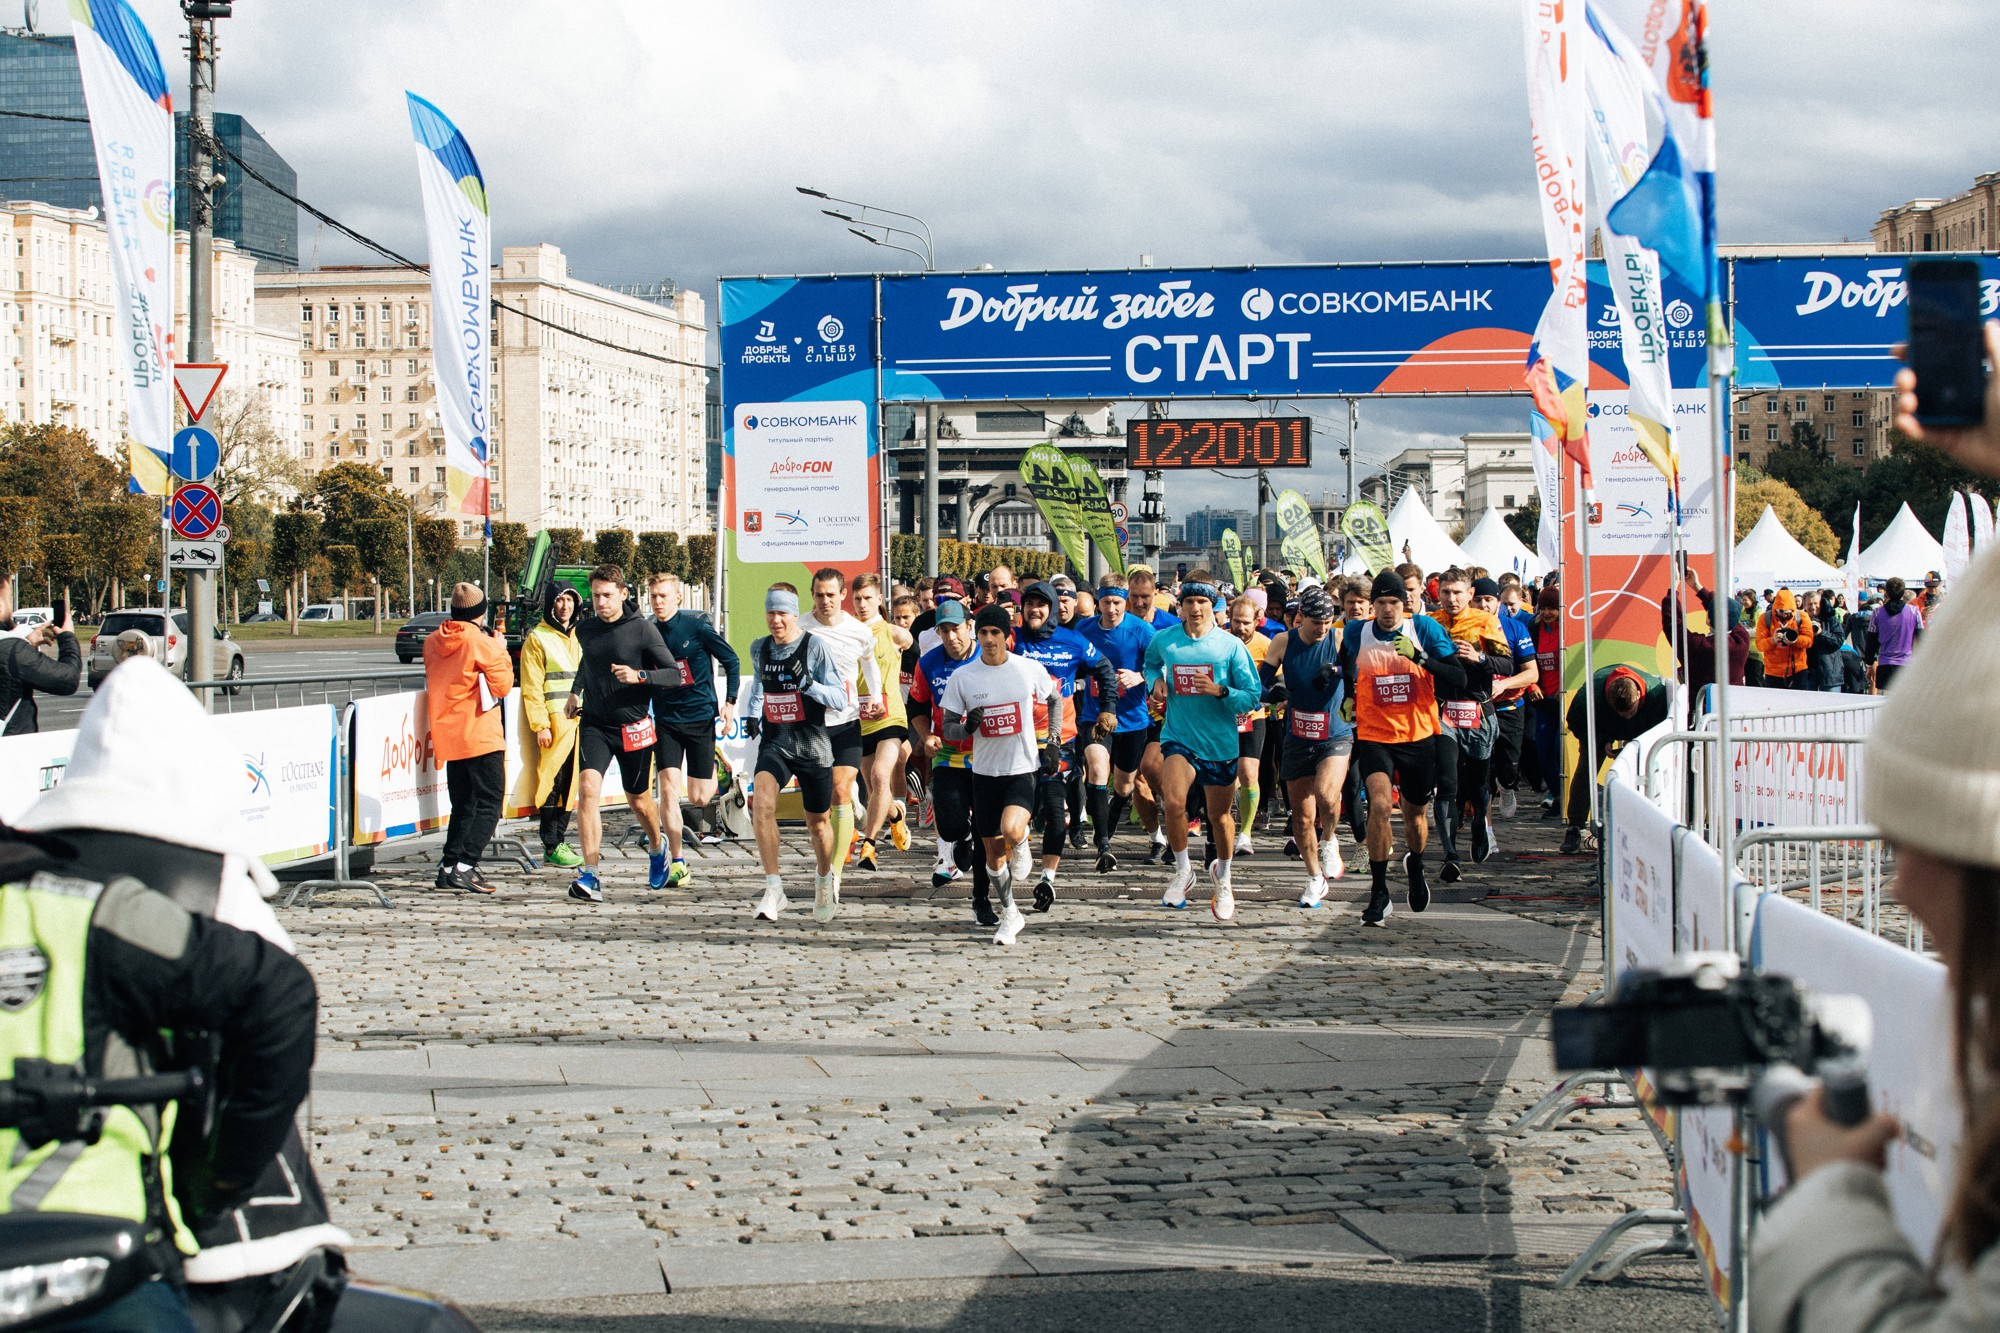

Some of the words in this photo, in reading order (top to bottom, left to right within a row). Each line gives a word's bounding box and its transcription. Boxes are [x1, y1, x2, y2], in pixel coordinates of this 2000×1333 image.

[1795, 267, 1910, 318] Добр
[939, 283, 1099, 331] Добрый
[1102, 280, 1215, 330] забег
[1278, 289, 1494, 315] СОВКОМБАНК
[1587, 330, 1622, 340] ДОБР
[1669, 330, 1705, 339] ТЕБЯ
[744, 345, 788, 355] ДОБРЫЕ
[822, 344, 855, 353] ТЕБЯ
[741, 354, 790, 364] ПРОЕКТЫ
[805, 353, 857, 362] СЛЫШУ
[1125, 332, 1311, 383] СТАРТ
[760, 415, 858, 428] СОВКОМБАНК
[768, 436, 803, 444] титульный
[1132, 420, 1309, 467] 12:20:01
[769, 456, 833, 474] ДоброFON
[1605, 475, 1654, 484] генеральный
[764, 484, 809, 493] генеральный
[818, 515, 862, 523] L'OCCITANE
[215, 530, 226, 538] 80
[1601, 531, 1653, 540] официальные
[761, 540, 809, 548] официальные
[1177, 676, 1188, 685] 10
[1377, 686, 1390, 695] 10
[1392, 684, 1410, 694] 621
[767, 704, 778, 713] 10
[779, 703, 799, 713] 673
[1446, 709, 1457, 718] 10
[1458, 711, 1476, 719] 329
[983, 718, 995, 727] 10
[997, 715, 1016, 726] 613
[1295, 720, 1304, 728] 10
[1305, 722, 1324, 730] 292
[628, 733, 640, 742] 10
[641, 727, 653, 738] 371
[281, 761, 324, 782] L'OCCITANE
